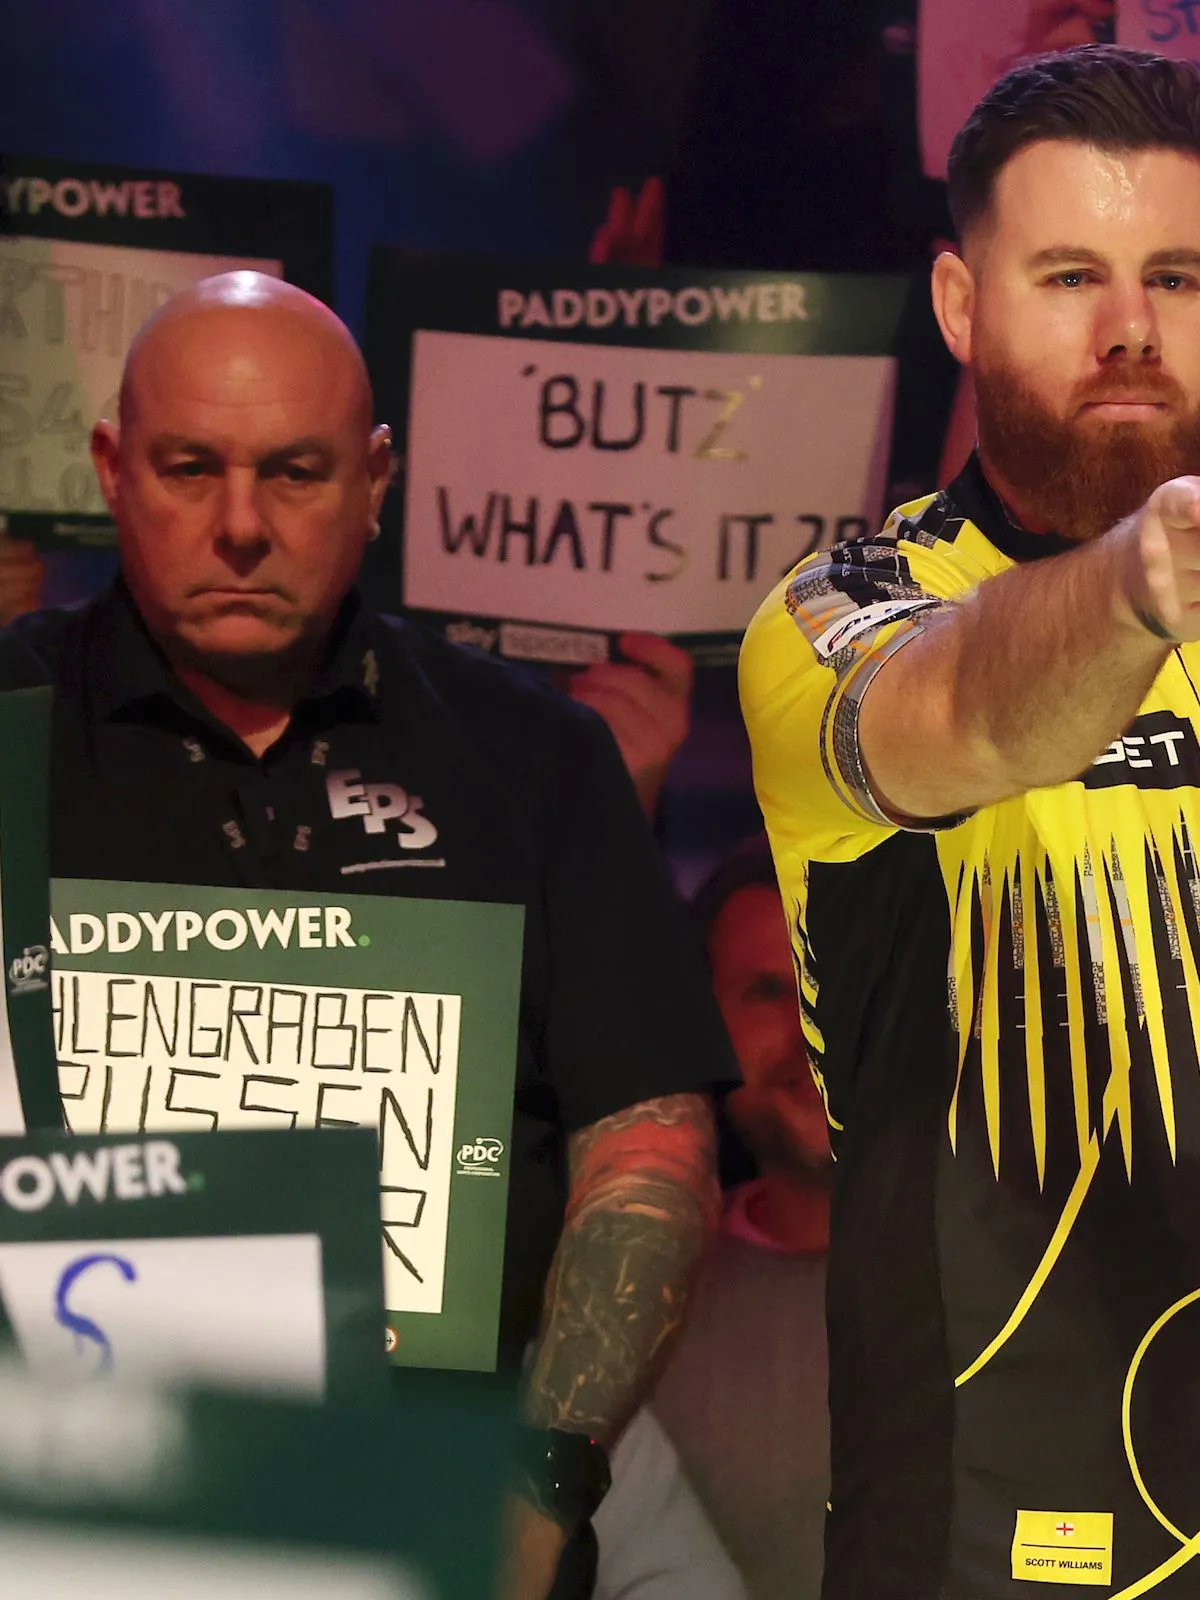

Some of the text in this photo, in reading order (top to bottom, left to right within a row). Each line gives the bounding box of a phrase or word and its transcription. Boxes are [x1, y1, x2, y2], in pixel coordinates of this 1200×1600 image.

[499, 283, 807, 327] PADDYPOWER
[437, 487, 688, 583] WHAT'S
[718, 513, 774, 581] IT
[326, 768, 438, 850] EPS
[461, 1144, 500, 1162] PDC
[1025, 1557, 1103, 1571] SCOTT WILLIAMS
